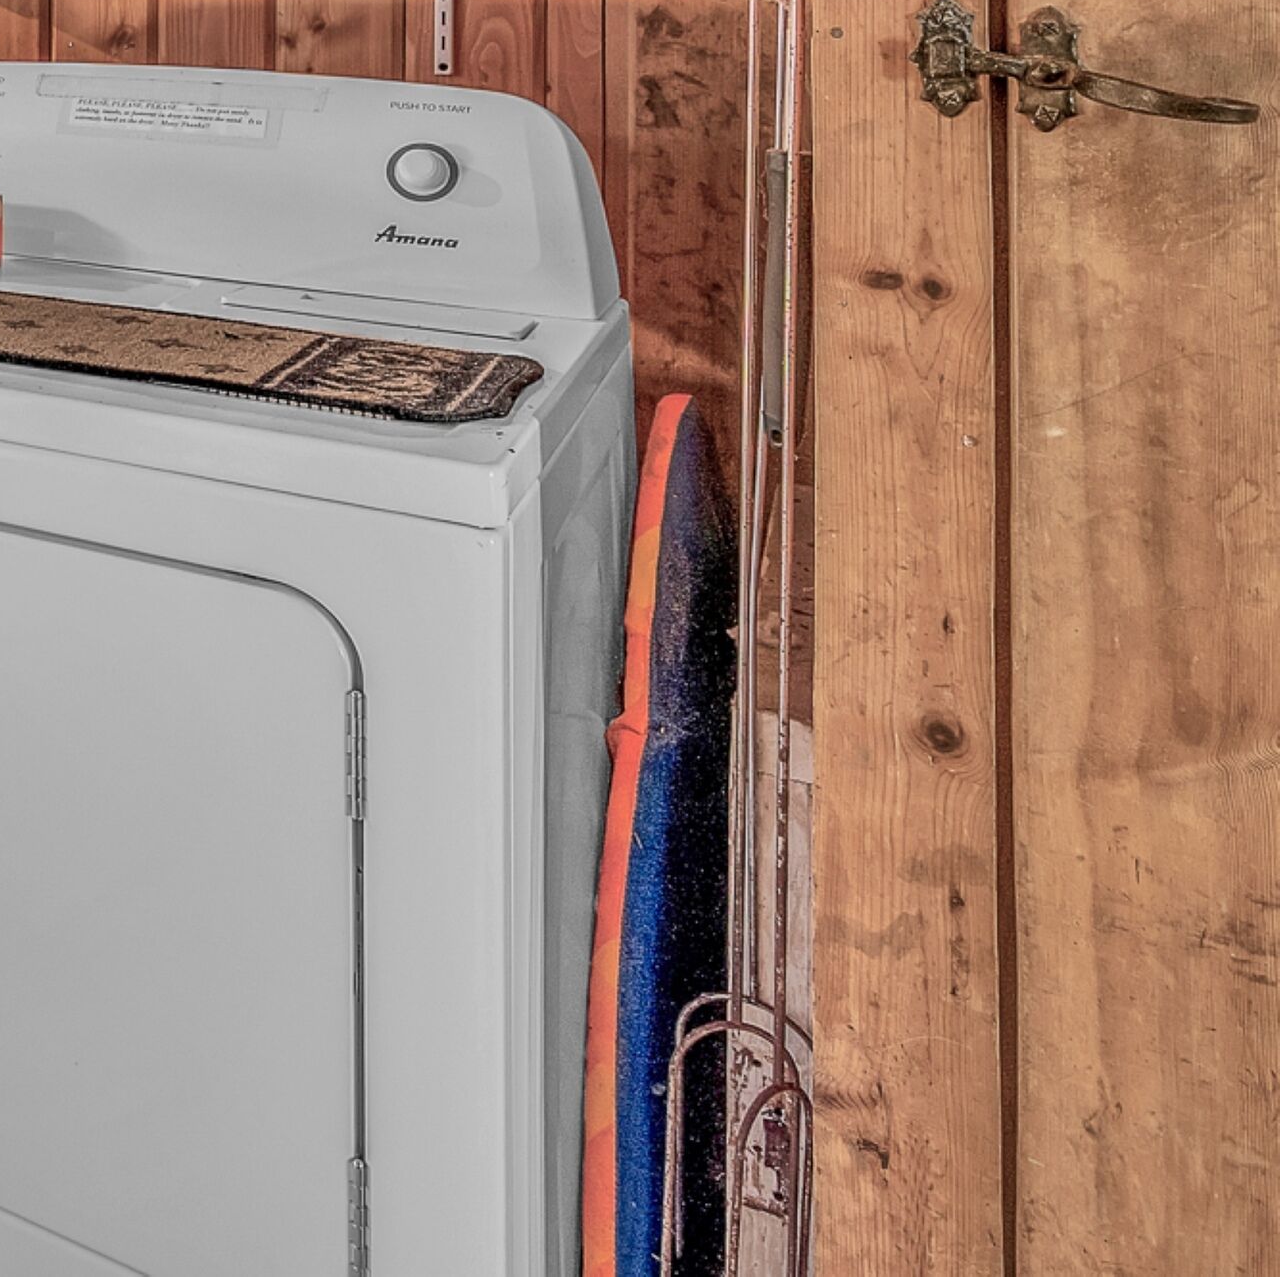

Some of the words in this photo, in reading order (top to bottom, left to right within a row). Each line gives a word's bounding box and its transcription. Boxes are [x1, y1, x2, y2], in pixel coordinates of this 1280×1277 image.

[390, 101, 419, 110] PUSH
[422, 103, 436, 111] TO
[438, 104, 472, 114] START
[374, 224, 460, 248] Amana
